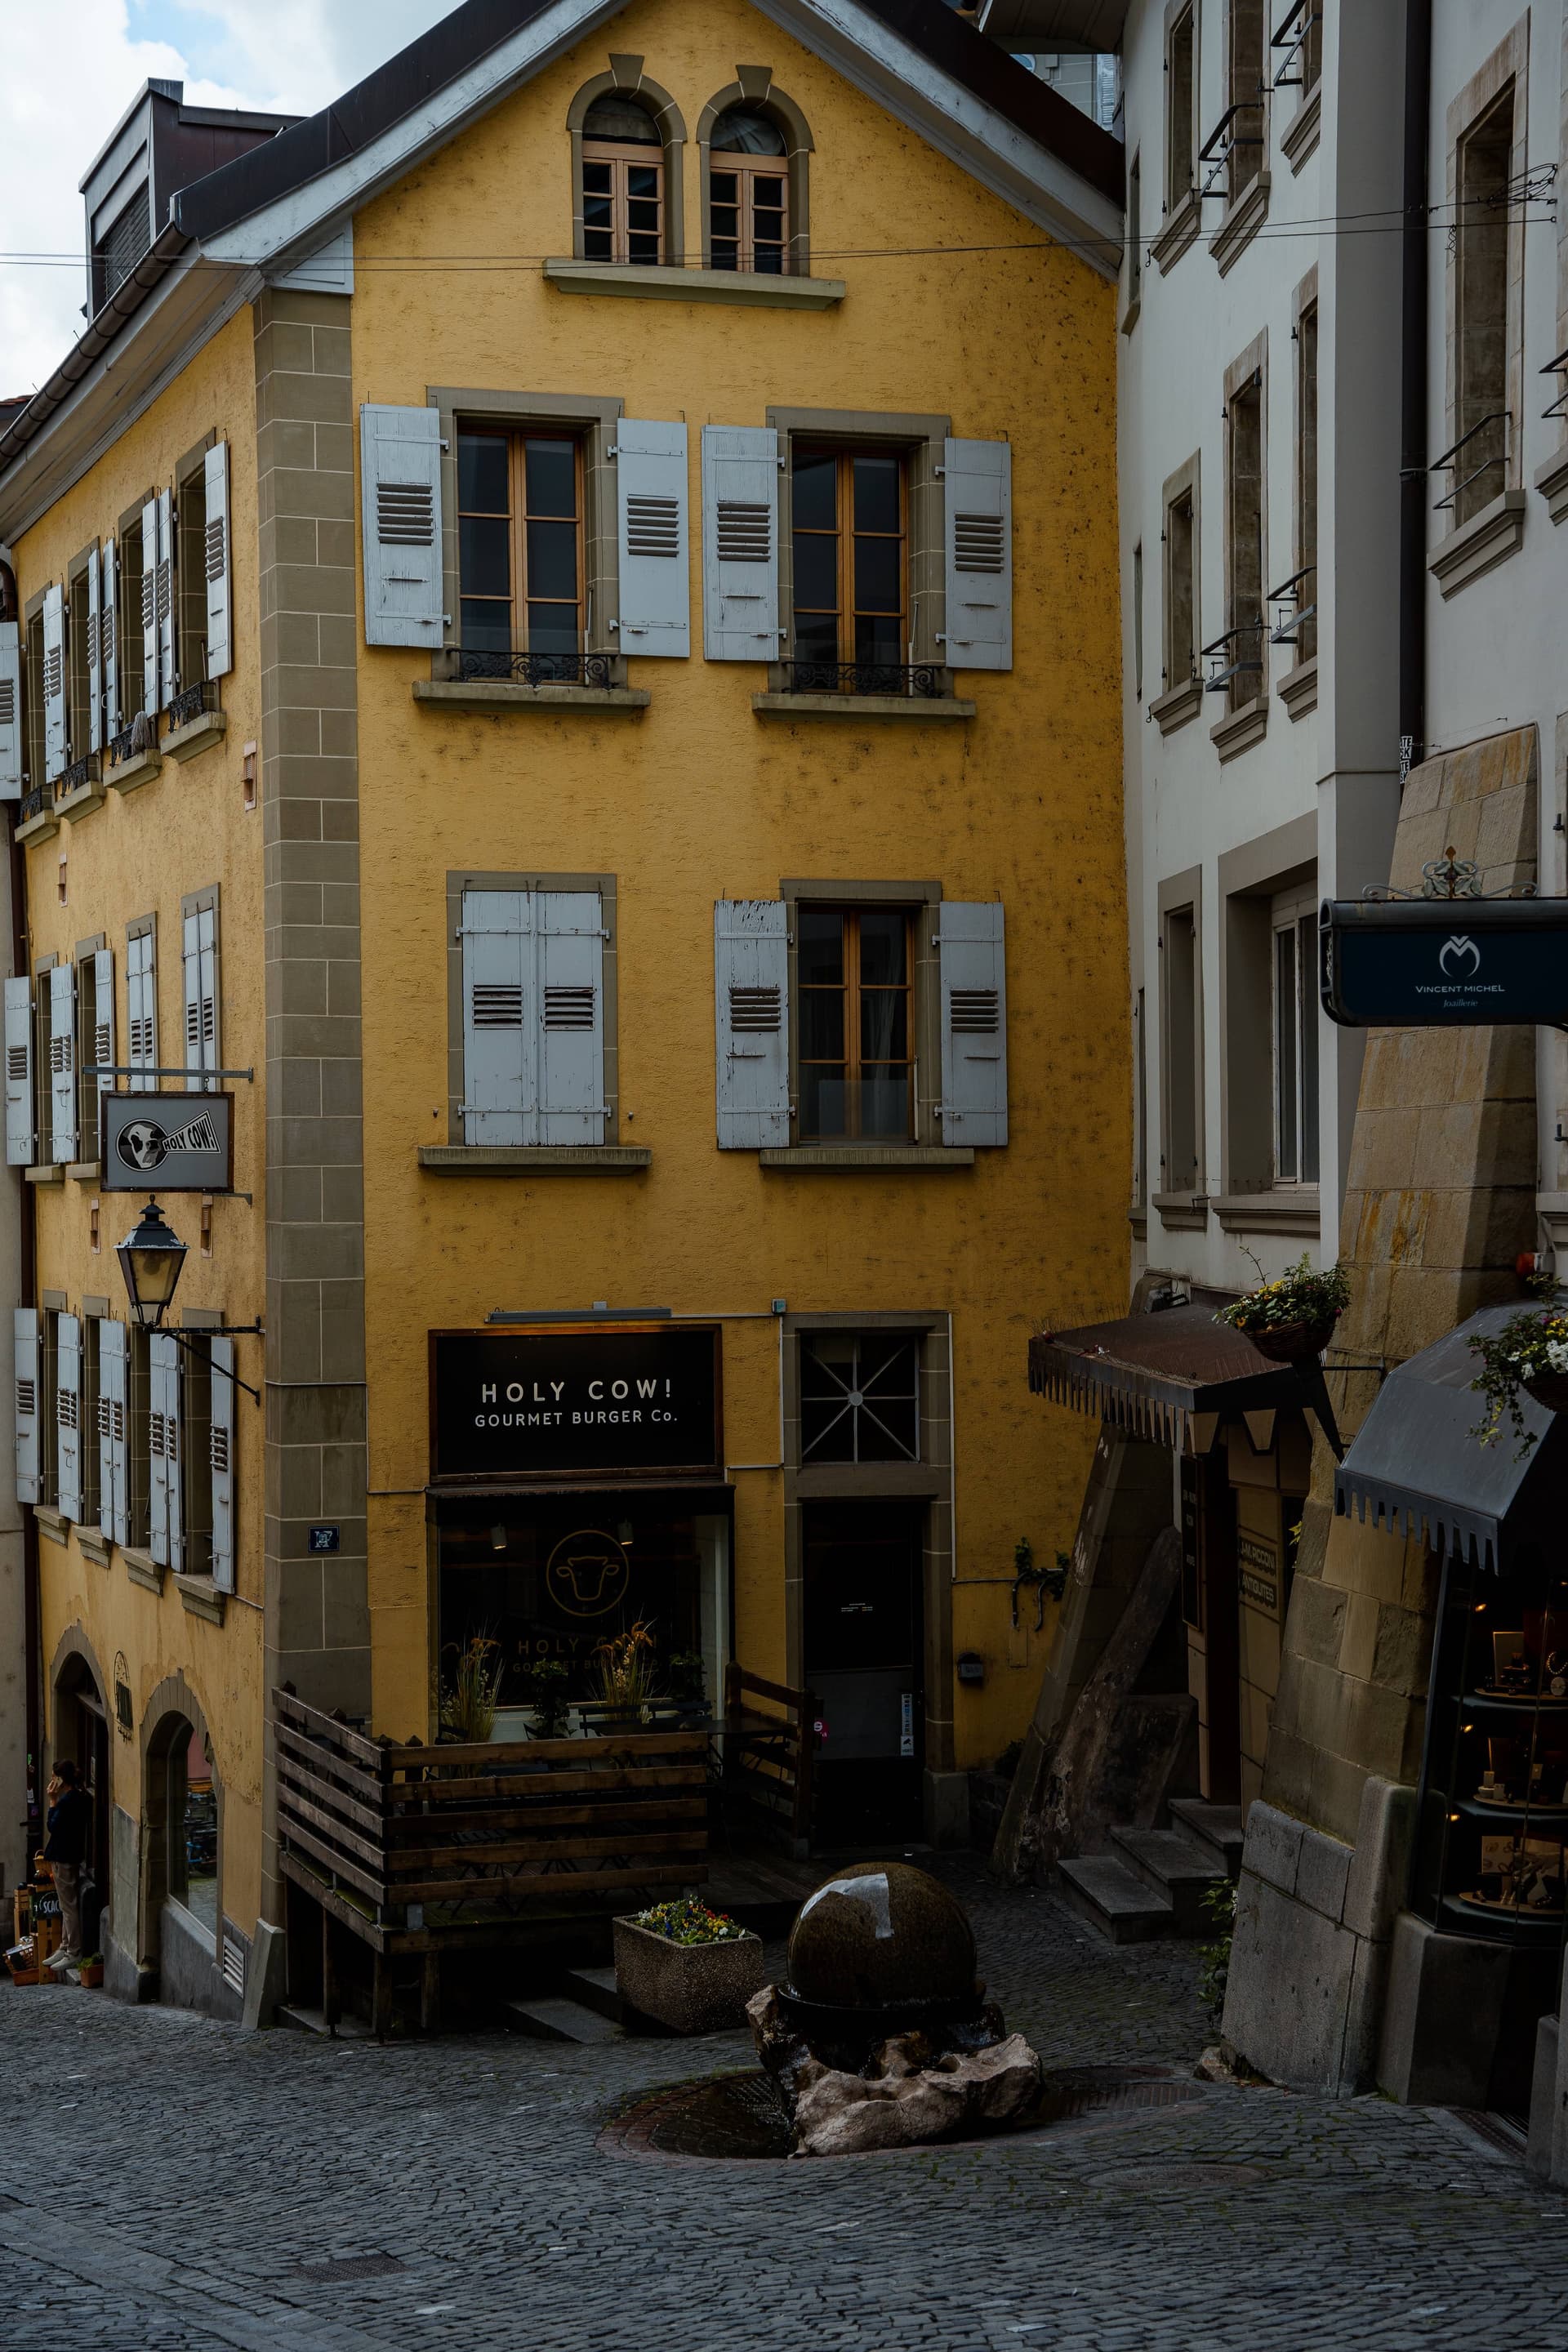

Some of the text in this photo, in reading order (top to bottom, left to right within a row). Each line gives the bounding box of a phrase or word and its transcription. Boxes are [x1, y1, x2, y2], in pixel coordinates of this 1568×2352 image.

[1415, 984, 1506, 993] VINCENT MICHEL
[163, 1117, 216, 1150] HOLY COW!
[481, 1379, 672, 1404] HOLY COW!
[474, 1409, 678, 1428] GOURMET BURGER Co.
[518, 1638, 579, 1654] HOLY
